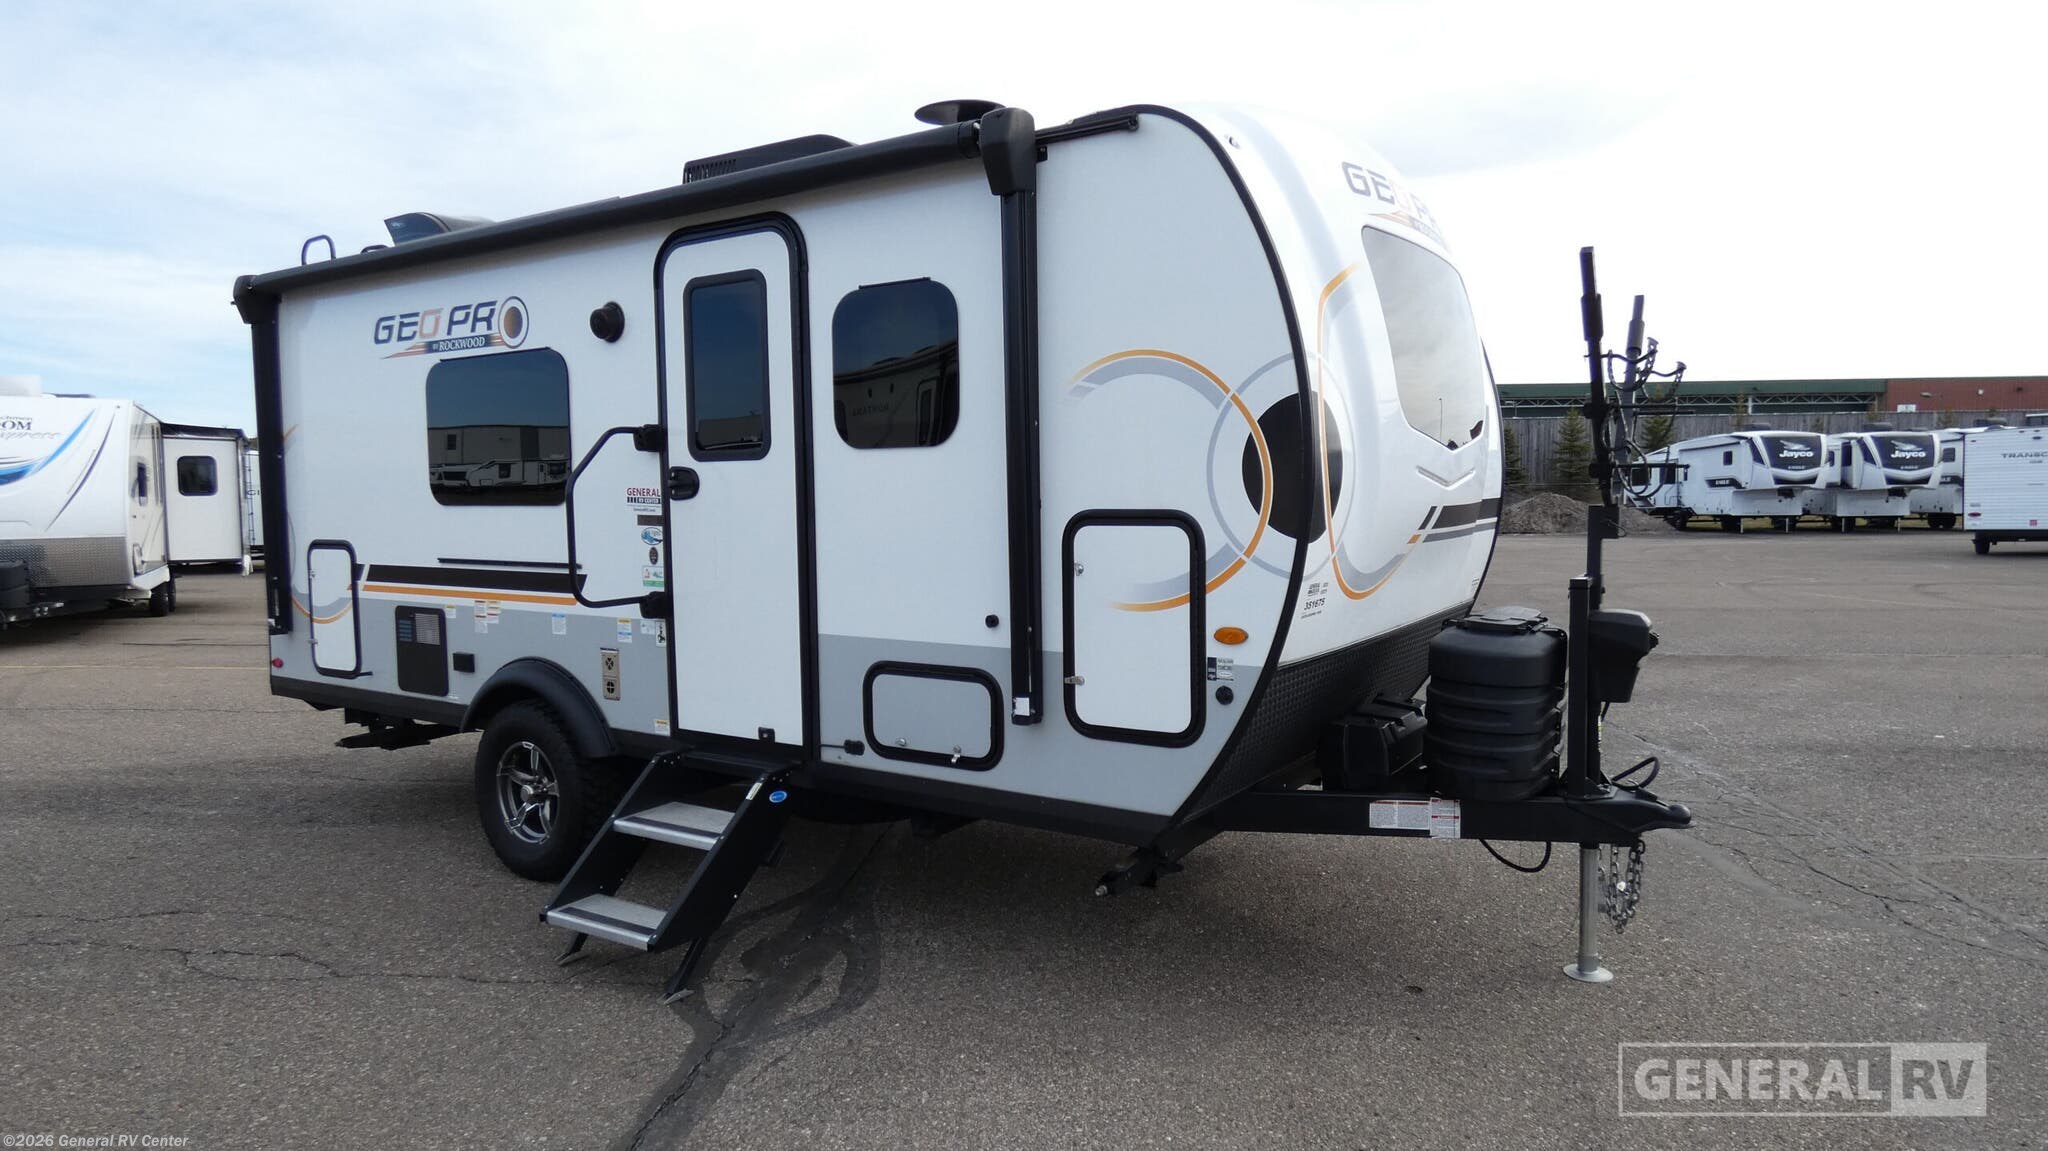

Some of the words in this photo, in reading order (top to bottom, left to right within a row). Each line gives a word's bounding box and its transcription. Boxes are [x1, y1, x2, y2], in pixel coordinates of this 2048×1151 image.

[374, 308, 444, 345] GEO
[439, 335, 486, 352] ROCKWOOD
[0, 420, 32, 431] OM
[1779, 450, 1815, 459] Jayco
[1890, 450, 1926, 459] Jayco
[626, 487, 661, 497] GENERAL
